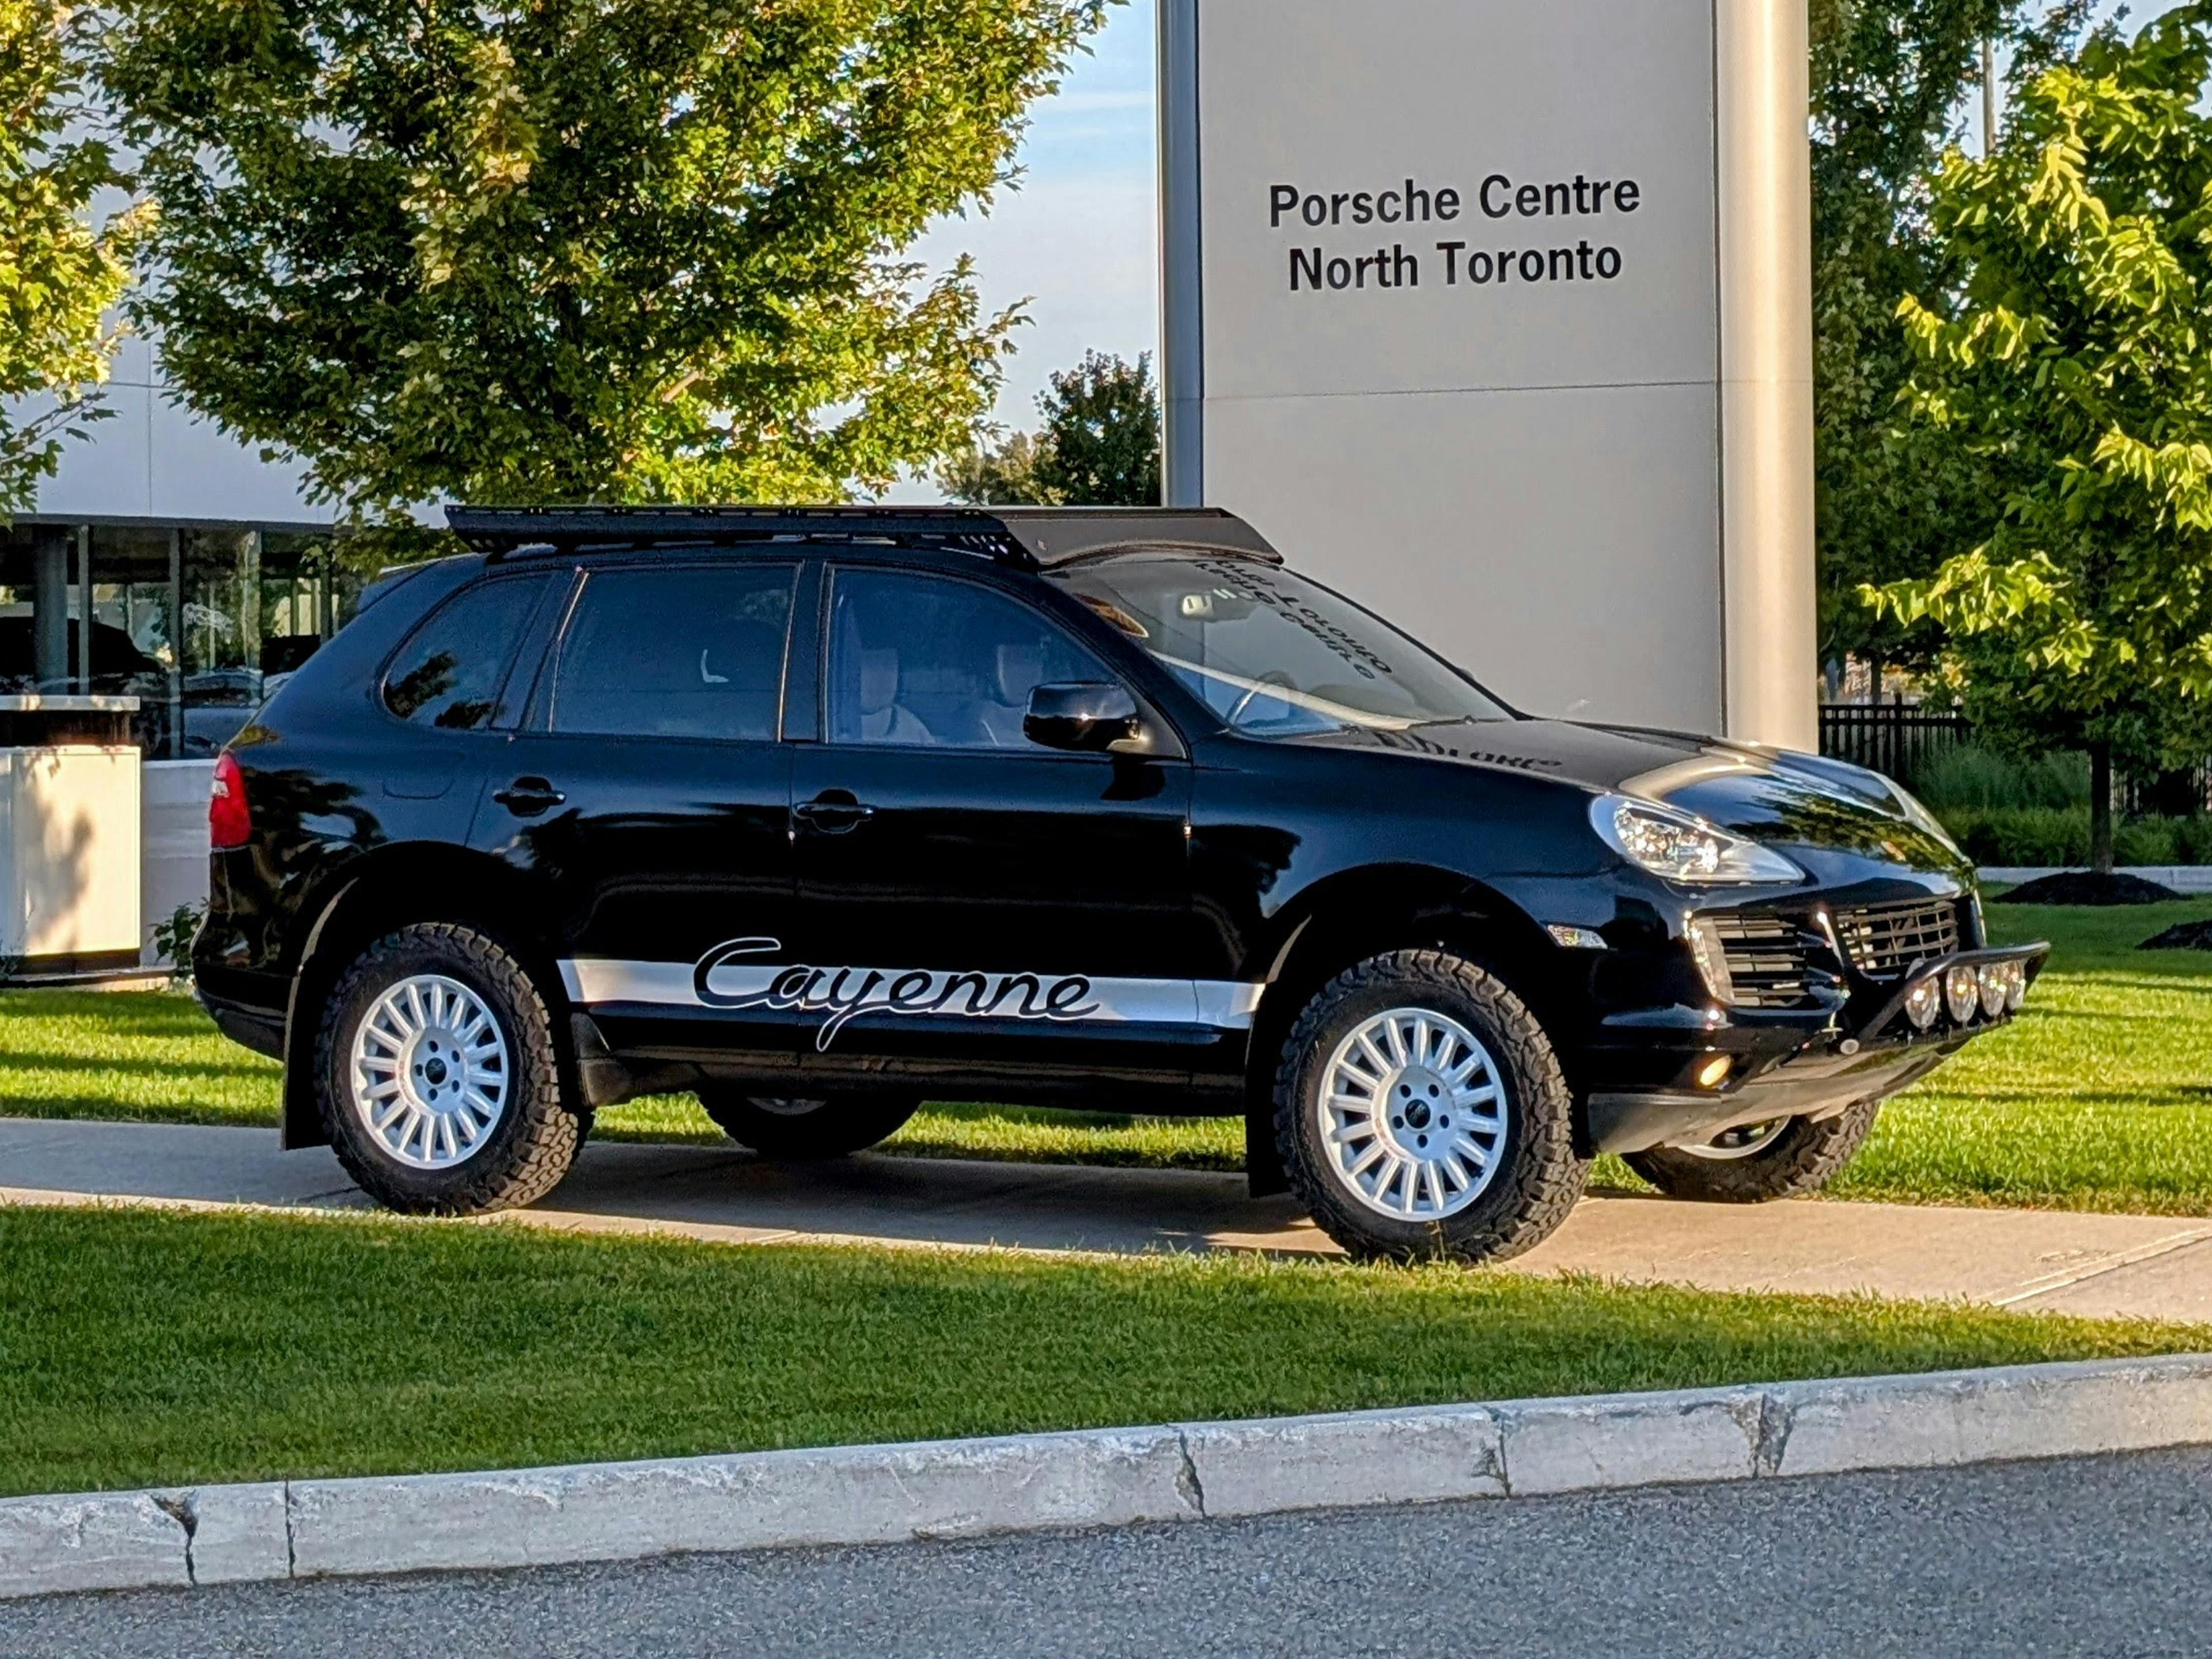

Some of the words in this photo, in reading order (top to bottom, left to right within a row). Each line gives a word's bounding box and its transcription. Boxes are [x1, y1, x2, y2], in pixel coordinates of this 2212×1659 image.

[1270, 179, 1460, 228] Porsche
[1479, 175, 1640, 218] Centre
[1290, 244, 1418, 291] North
[1436, 241, 1622, 285] Toronto
[693, 937, 1101, 1052] Cayenne
